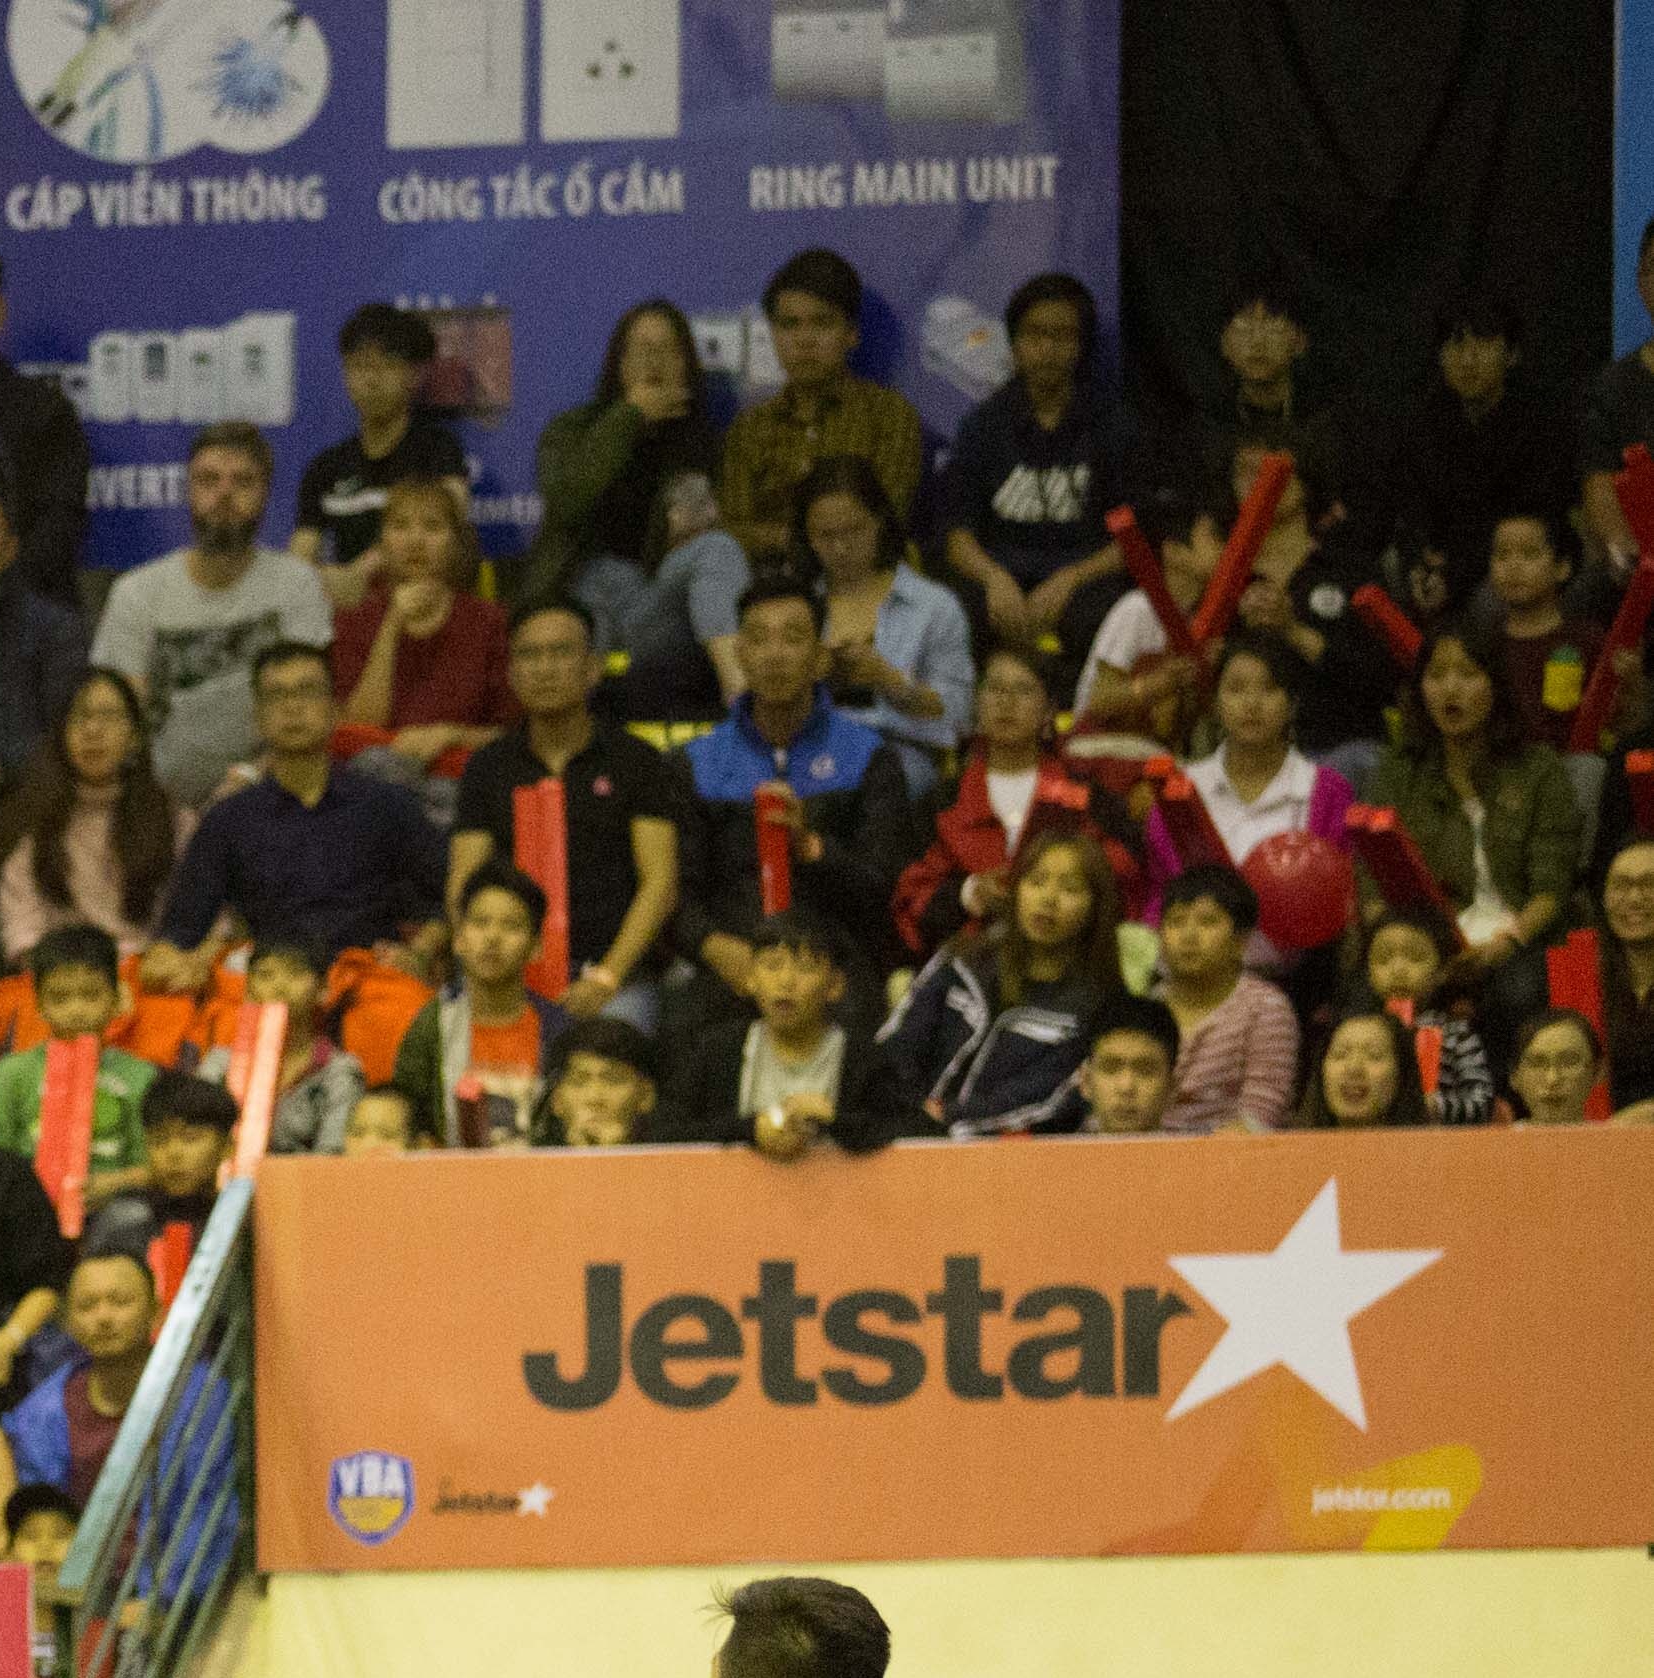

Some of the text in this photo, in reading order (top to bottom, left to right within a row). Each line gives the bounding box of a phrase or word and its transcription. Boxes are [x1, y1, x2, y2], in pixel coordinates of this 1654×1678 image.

[5, 174, 87, 232] CÁP
[188, 167, 328, 224] THÔNG
[377, 168, 486, 225] CÔNG
[749, 155, 1060, 213] RING MAIN UNIT
[521, 1255, 1192, 1412] Jetstar
[337, 1454, 406, 1498] VBA
